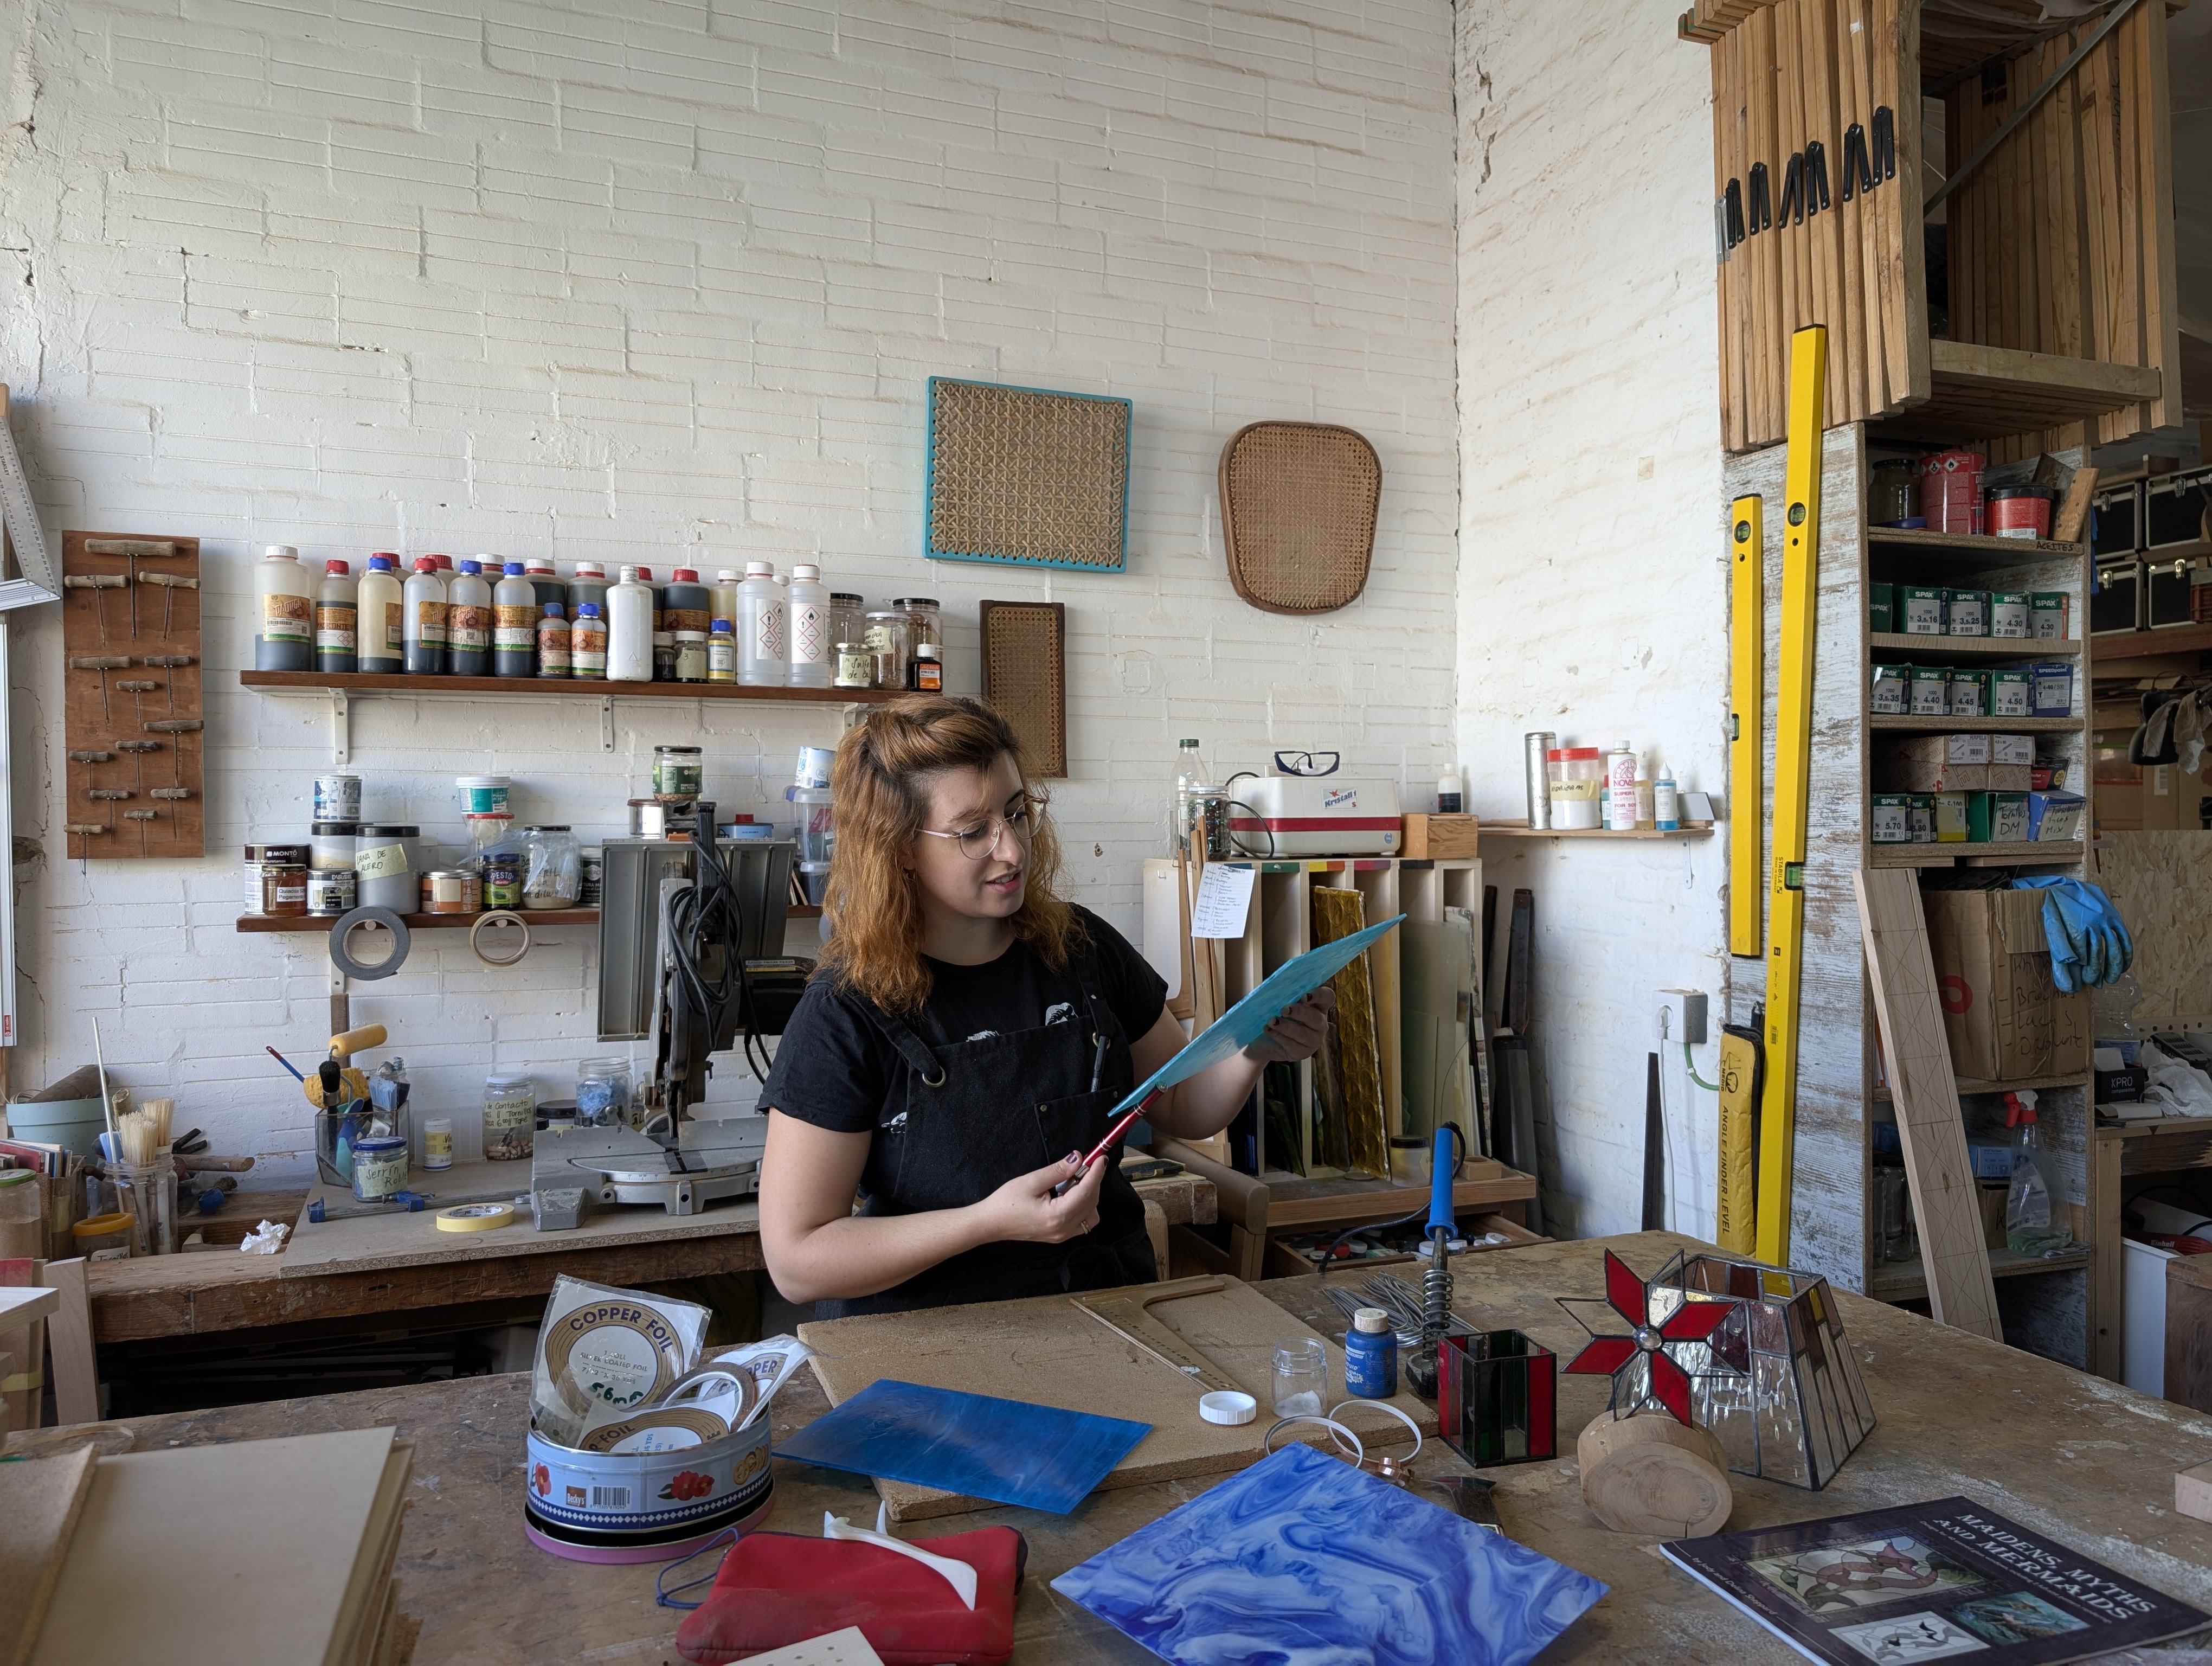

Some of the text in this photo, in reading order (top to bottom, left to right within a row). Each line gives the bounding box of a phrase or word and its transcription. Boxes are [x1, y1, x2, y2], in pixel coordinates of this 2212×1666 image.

[1, 456, 10, 476] STANLEY
[2036, 542, 2074, 552] ACEITES
[274, 597, 303, 617] PAORGA
[1325, 792, 1352, 808] Kristall
[2000, 821, 2020, 835] DM
[357, 849, 387, 864] LANA DE
[361, 861, 383, 874] ACERO
[492, 872, 512, 880] PESTO
[2111, 1077, 2133, 1088] KPRO
[496, 1100, 528, 1110] Contacto
[506, 1107, 531, 1118] Tornillos
[366, 1164, 398, 1180] Serrín
[1721, 1197, 1729, 1234] LEVEL
[2150, 1239, 2175, 1247] Einhell
[570, 1307, 673, 1353] COPPER FOIL
[604, 1358, 631, 1368] COATED
[599, 1425, 635, 1442] FOIL
[568, 1493, 586, 1506] Becky's
[1933, 1520, 2134, 1620] AND MERMAIDS
[1956, 1514, 2158, 1613] MAIDENS, MYTHS
[1697, 1564, 1715, 1572] Jody
[1745, 1594, 1778, 1615] Sheppard
